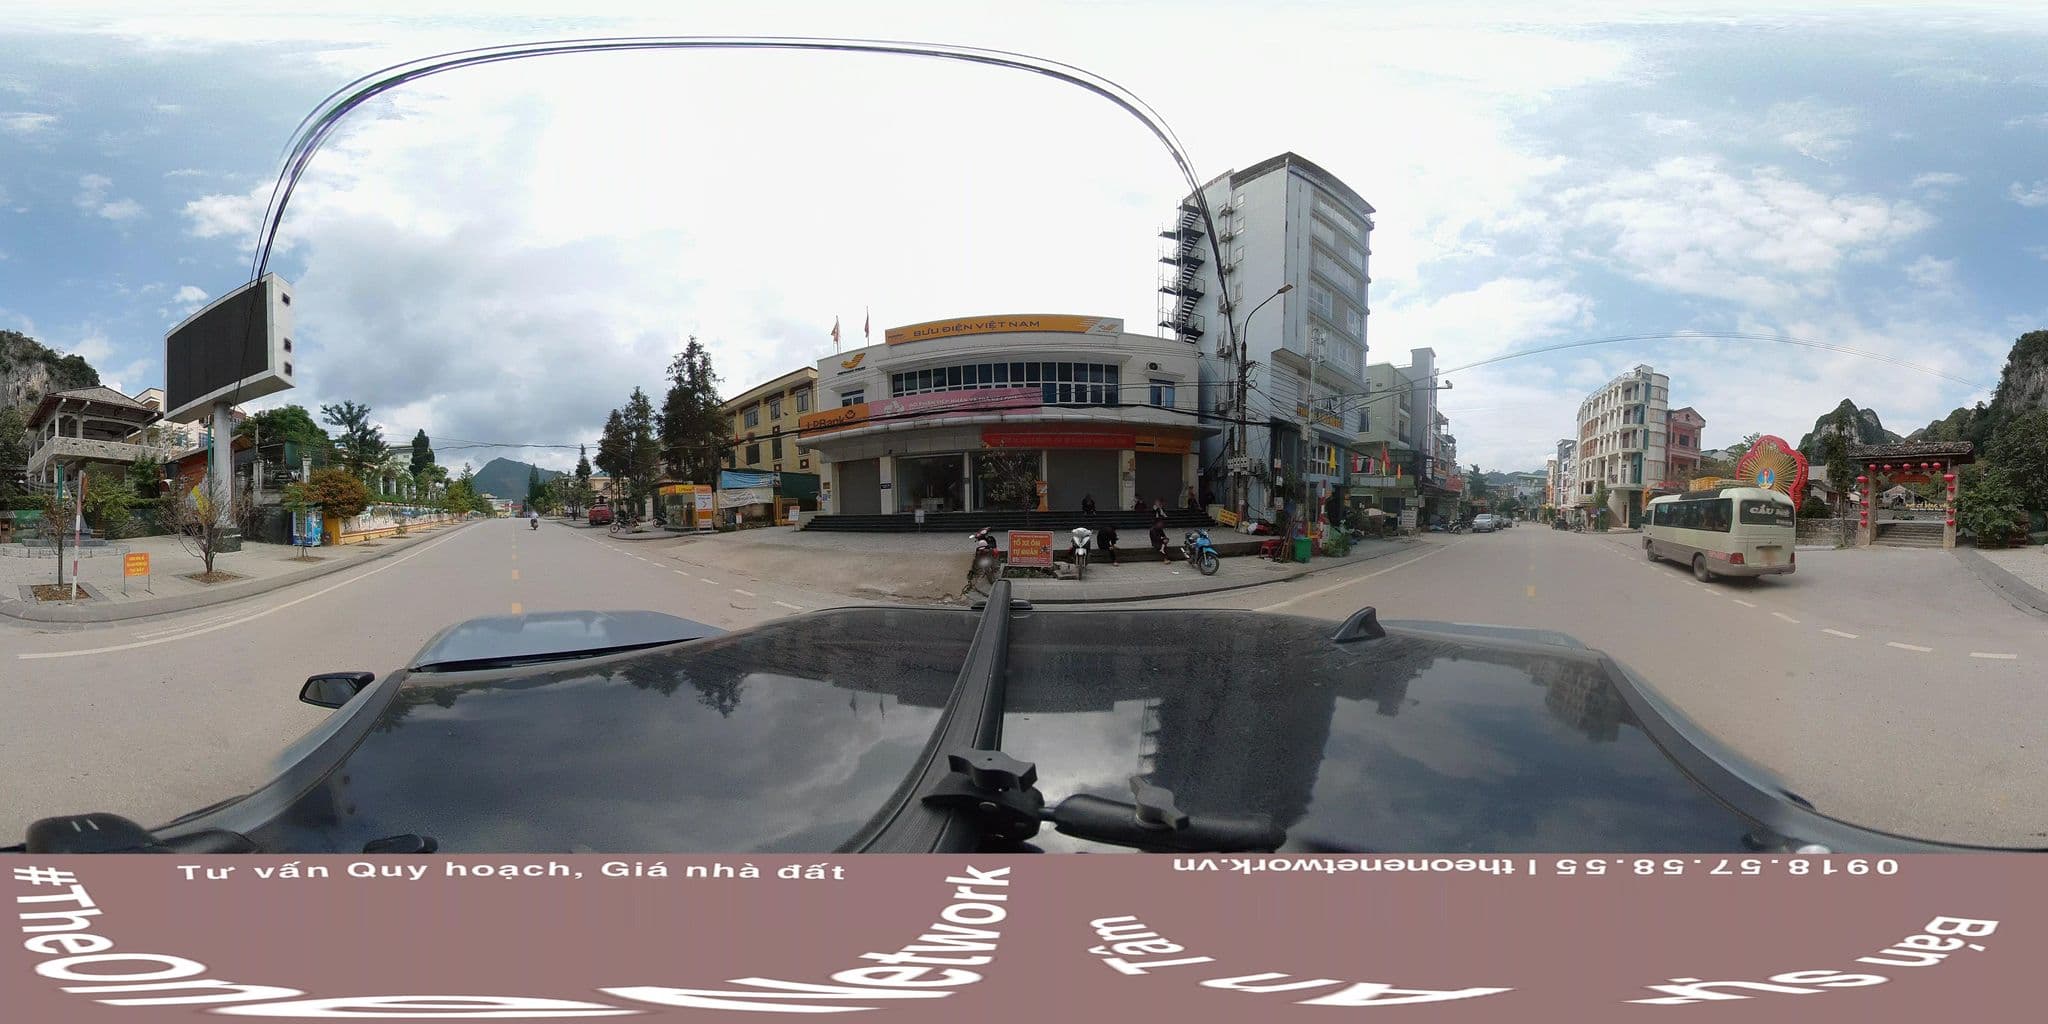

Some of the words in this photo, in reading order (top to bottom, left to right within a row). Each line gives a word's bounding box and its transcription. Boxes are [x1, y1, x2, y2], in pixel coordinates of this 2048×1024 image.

[913, 327, 939, 337] BƯU
[942, 323, 973, 334] ĐIỆN
[975, 320, 1006, 331] VIỆT
[1008, 320, 1040, 328] NAM
